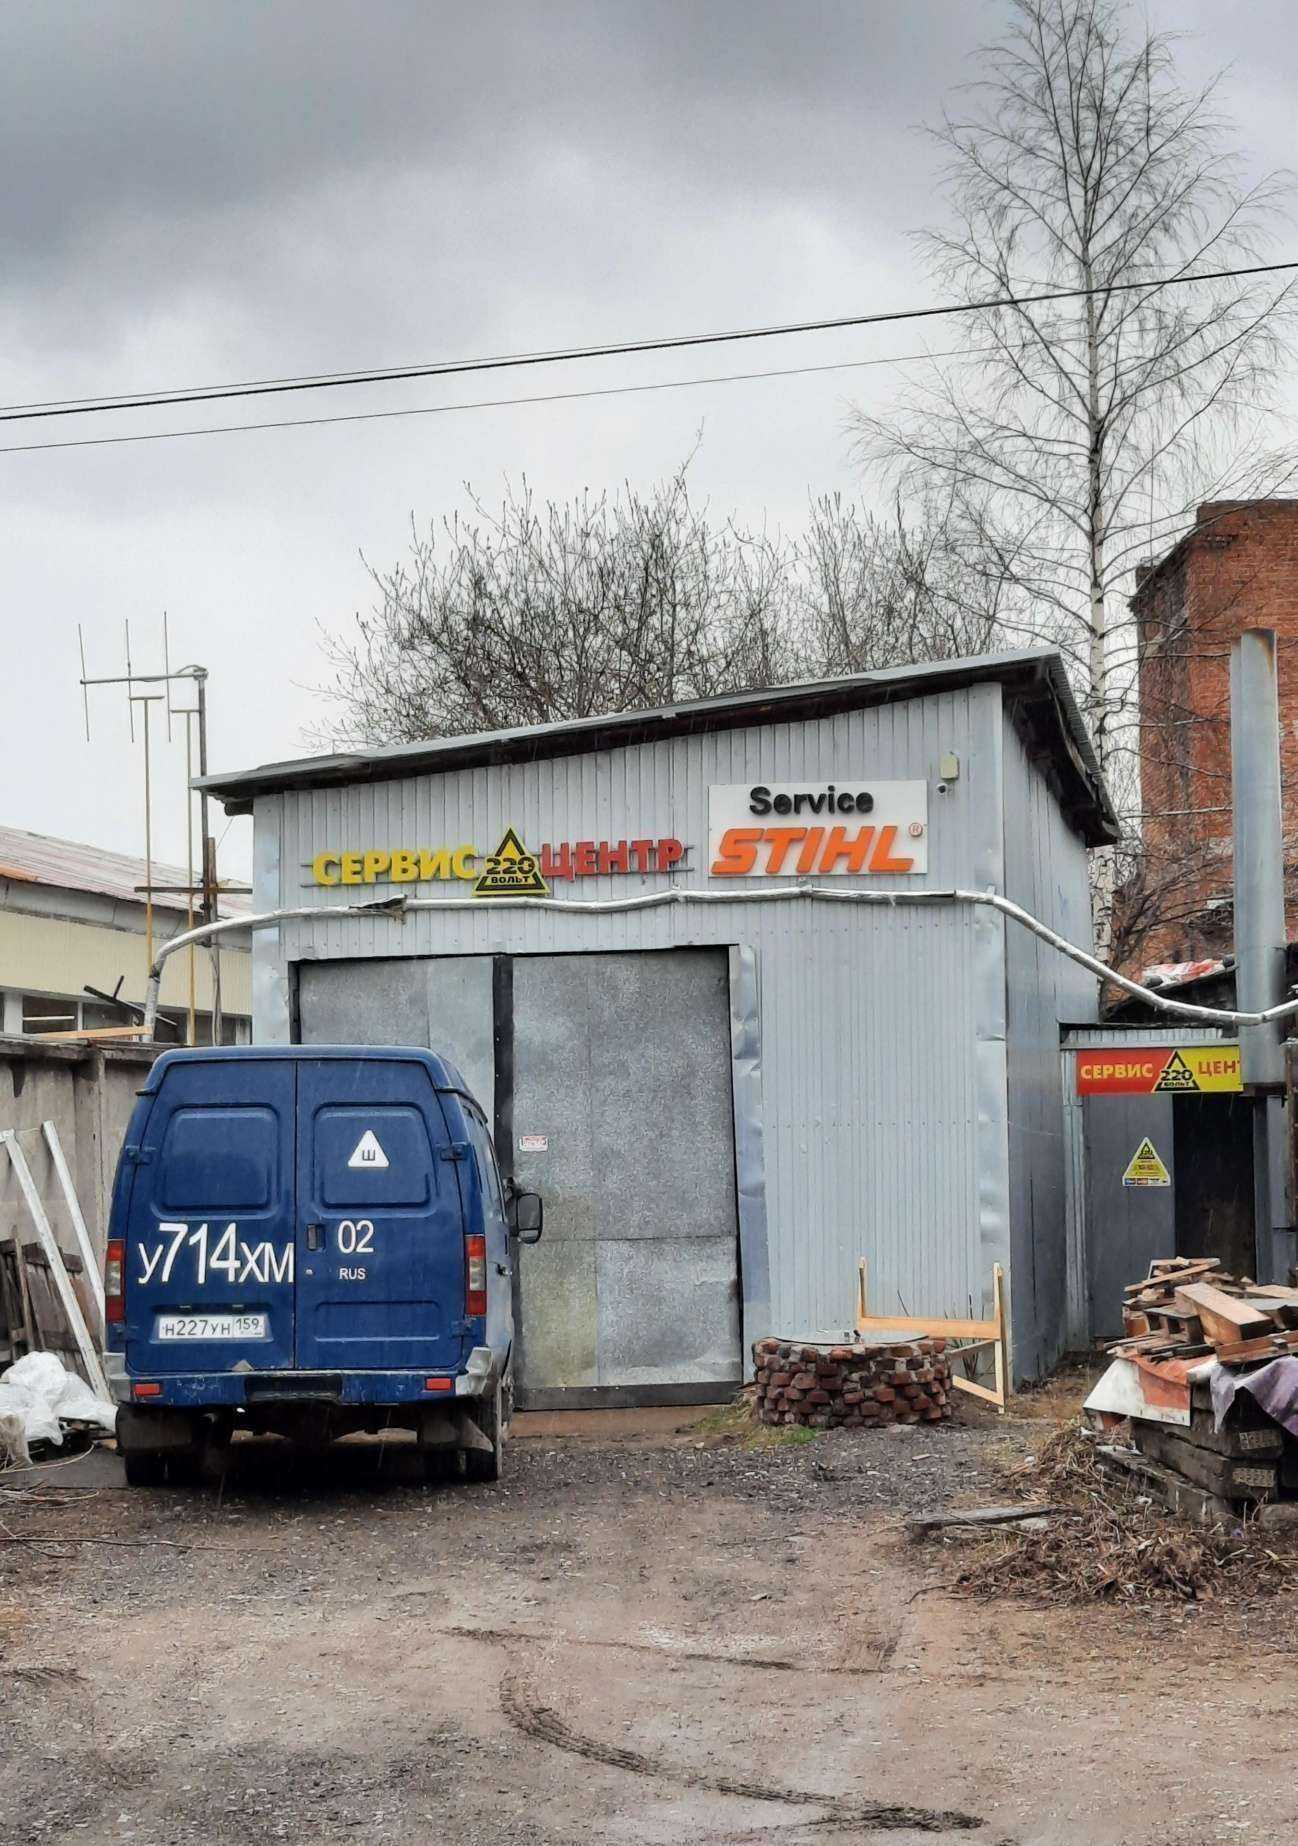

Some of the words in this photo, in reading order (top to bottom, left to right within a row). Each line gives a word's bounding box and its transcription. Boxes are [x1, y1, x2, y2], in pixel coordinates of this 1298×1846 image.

[750, 785, 874, 816] Service
[711, 825, 914, 874] STIHL
[312, 845, 477, 886] СЕРВИС
[485, 856, 535, 875] 220
[541, 838, 684, 882] ЦЕНТР
[490, 875, 529, 884] ВОЛЬТ
[1080, 1064, 1153, 1080] СЕРВИС
[1160, 1069, 1194, 1082] 220
[1198, 1060, 1241, 1078] ЦЕН
[361, 1149, 376, 1162] Ш
[337, 1220, 375, 1254] 02
[338, 1267, 367, 1280] RUS
[236, 1317, 259, 1330] 159
